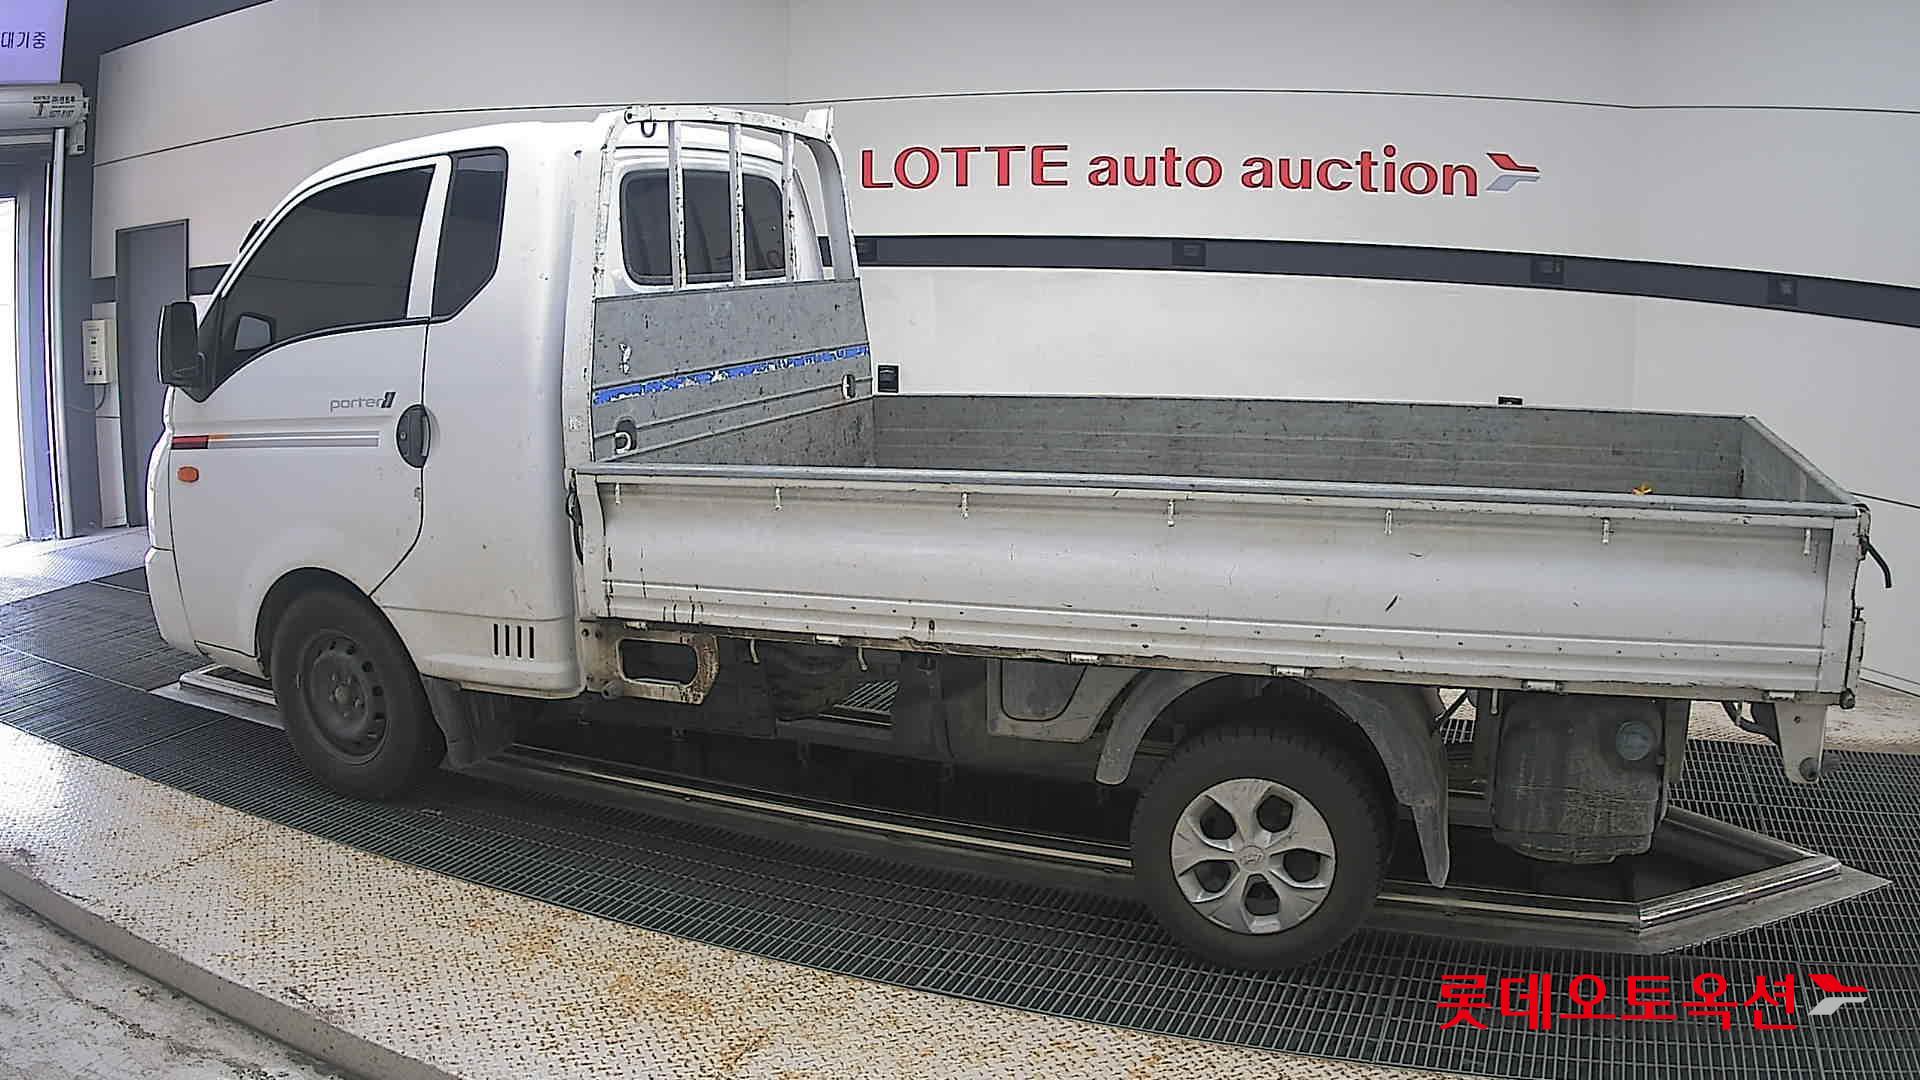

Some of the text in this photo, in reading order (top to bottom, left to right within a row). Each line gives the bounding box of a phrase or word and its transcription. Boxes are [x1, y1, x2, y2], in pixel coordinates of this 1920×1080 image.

[1, 31, 46, 49] 대기중
[861, 145, 1478, 197] LOTTE auto auction
